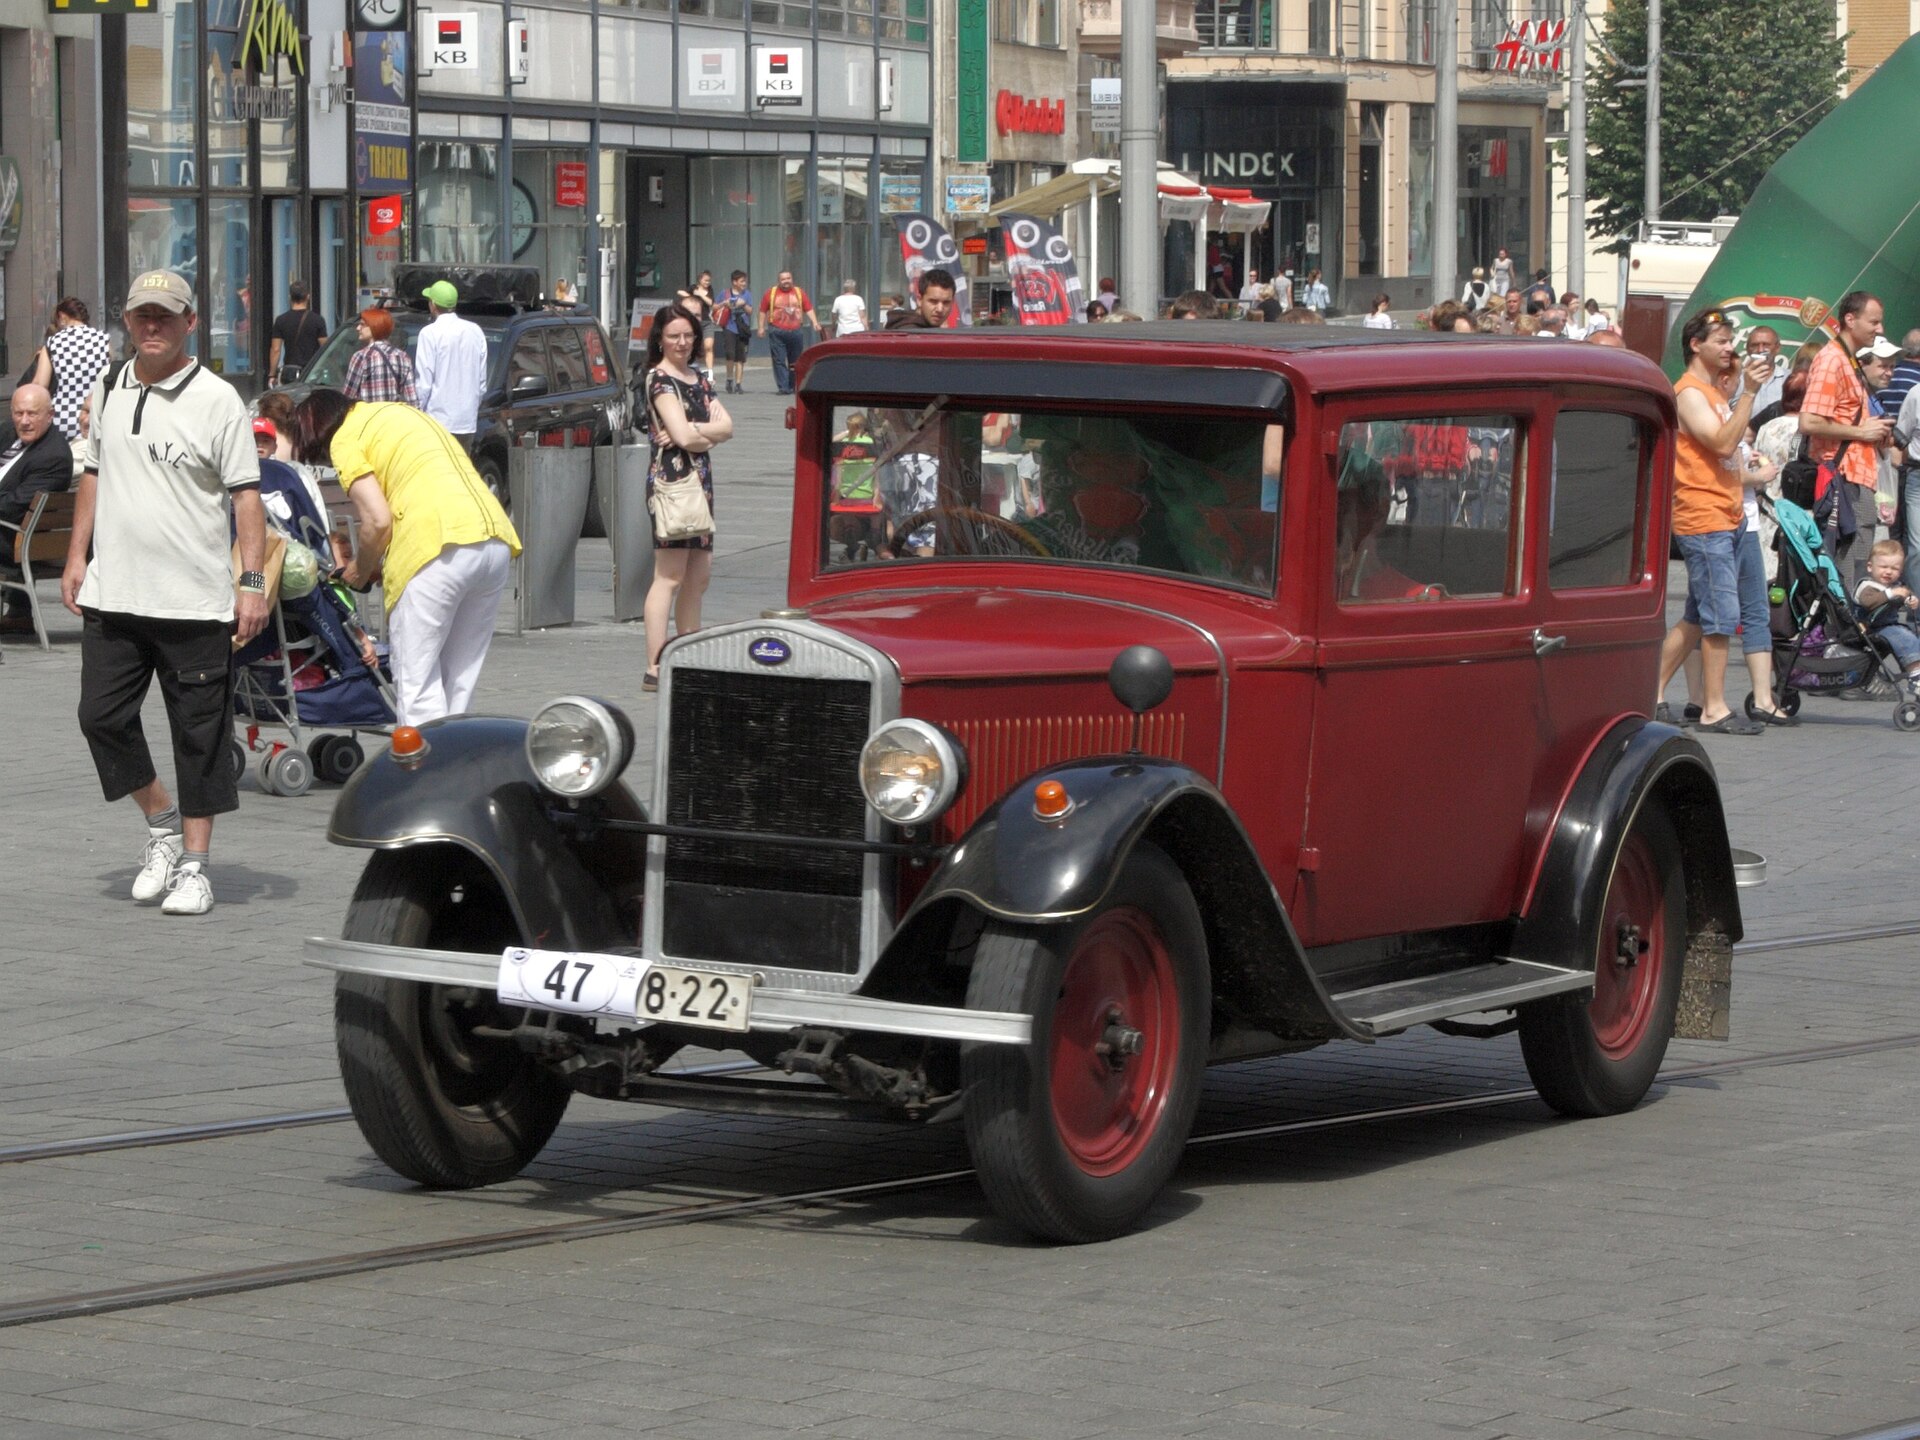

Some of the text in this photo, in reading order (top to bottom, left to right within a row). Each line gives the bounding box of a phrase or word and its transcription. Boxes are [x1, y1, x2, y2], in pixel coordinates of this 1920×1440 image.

[433, 50, 468, 64] KB
[765, 79, 794, 91] KB
[543, 959, 595, 1003] 47
